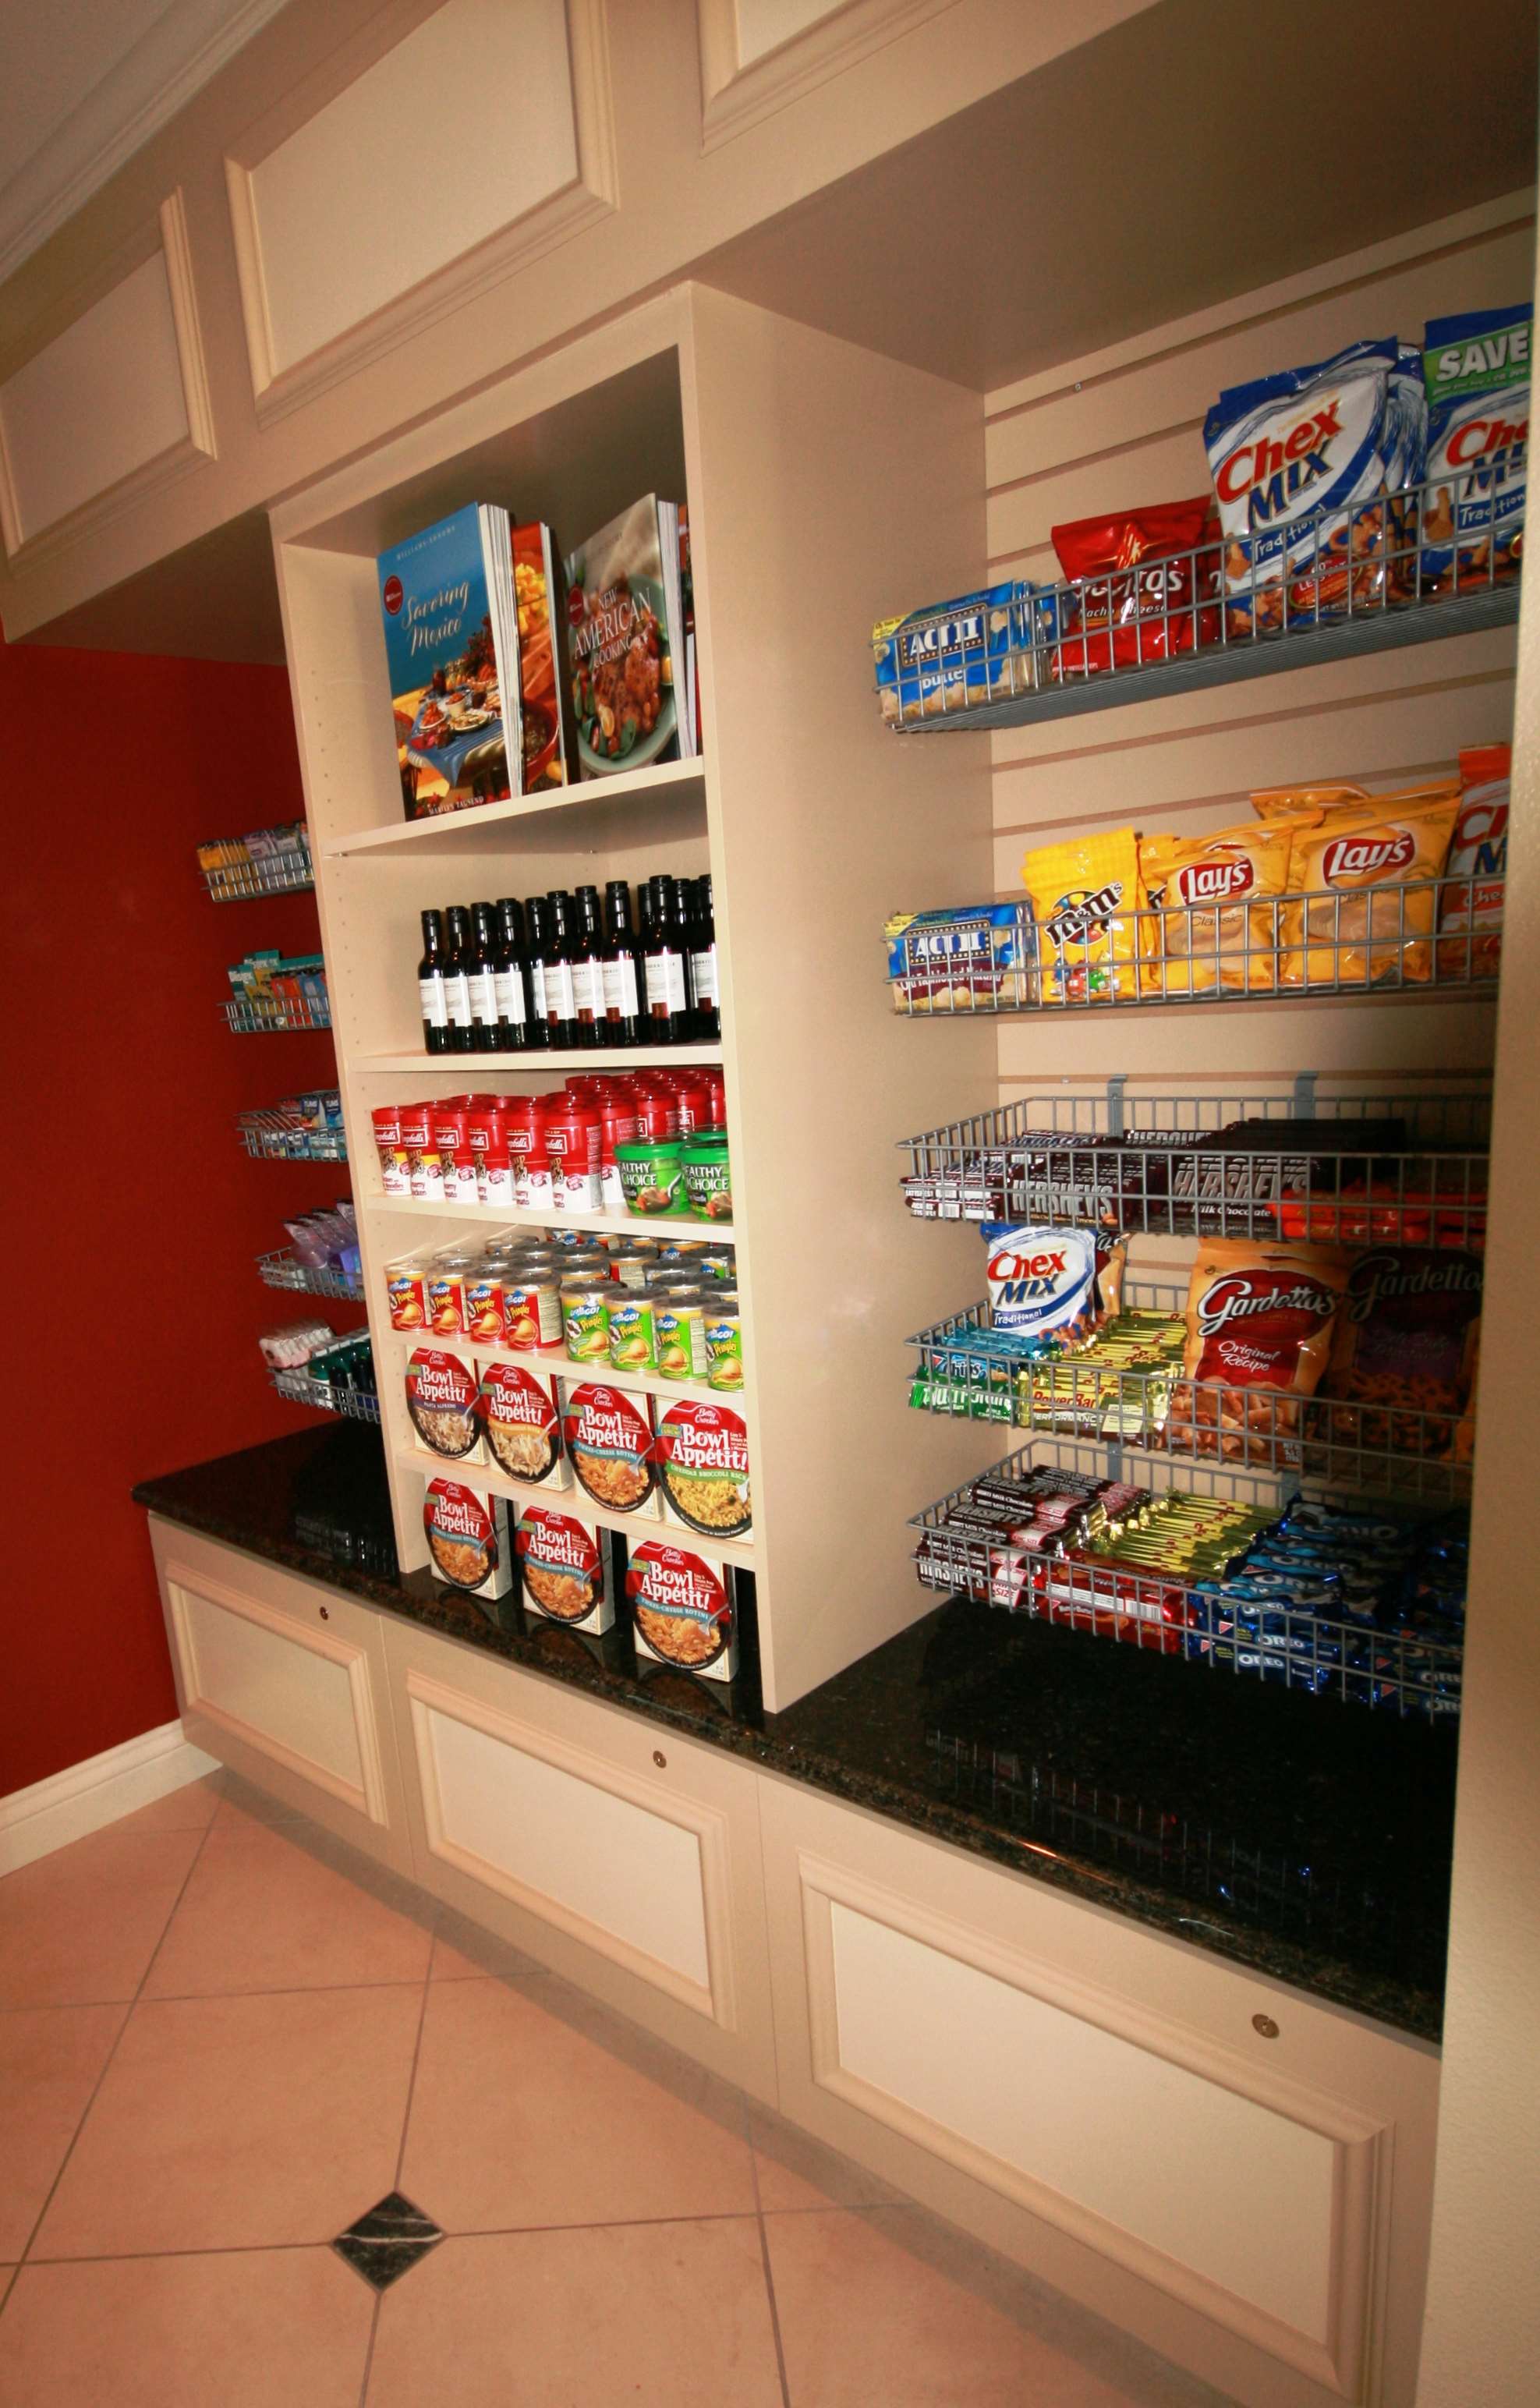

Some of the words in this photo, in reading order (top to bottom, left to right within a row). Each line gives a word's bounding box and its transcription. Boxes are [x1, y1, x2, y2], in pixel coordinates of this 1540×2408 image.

[1436, 328, 1529, 382] SAVE
[1216, 398, 1345, 504] Chex
[1248, 444, 1333, 530] MIX
[401, 581, 469, 630] Savoring
[598, 586, 618, 609] NEW
[409, 615, 462, 657] Mexico
[575, 586, 652, 660] AMERICAN
[593, 633, 632, 668] COOKING
[986, 1249, 1067, 1283] Chex
[996, 1273, 1060, 1306] MIX
[993, 1308, 1043, 1326] Traditional
[1218, 1340, 1281, 1362] Original
[1221, 1352, 1269, 1373] Recipe
[416, 1377, 466, 1403] Appétit!
[421, 1364, 454, 1387] Bowl
[490, 1397, 543, 1425] Appétit!
[495, 1383, 530, 1408] Bowl
[583, 1404, 623, 1432] Bowl
[577, 1418, 637, 1450] Appétit!
[680, 1423, 731, 1450] Bowl
[670, 1438, 748, 1471] Appétit!
[434, 1507, 480, 1538] Appétit!
[438, 1495, 469, 1521] Bowl
[535, 1521, 572, 1549] Bowl
[528, 1535, 585, 1568] Appétit!
[649, 1560, 694, 1590] Bowl
[639, 1574, 710, 1610] Appétit!
